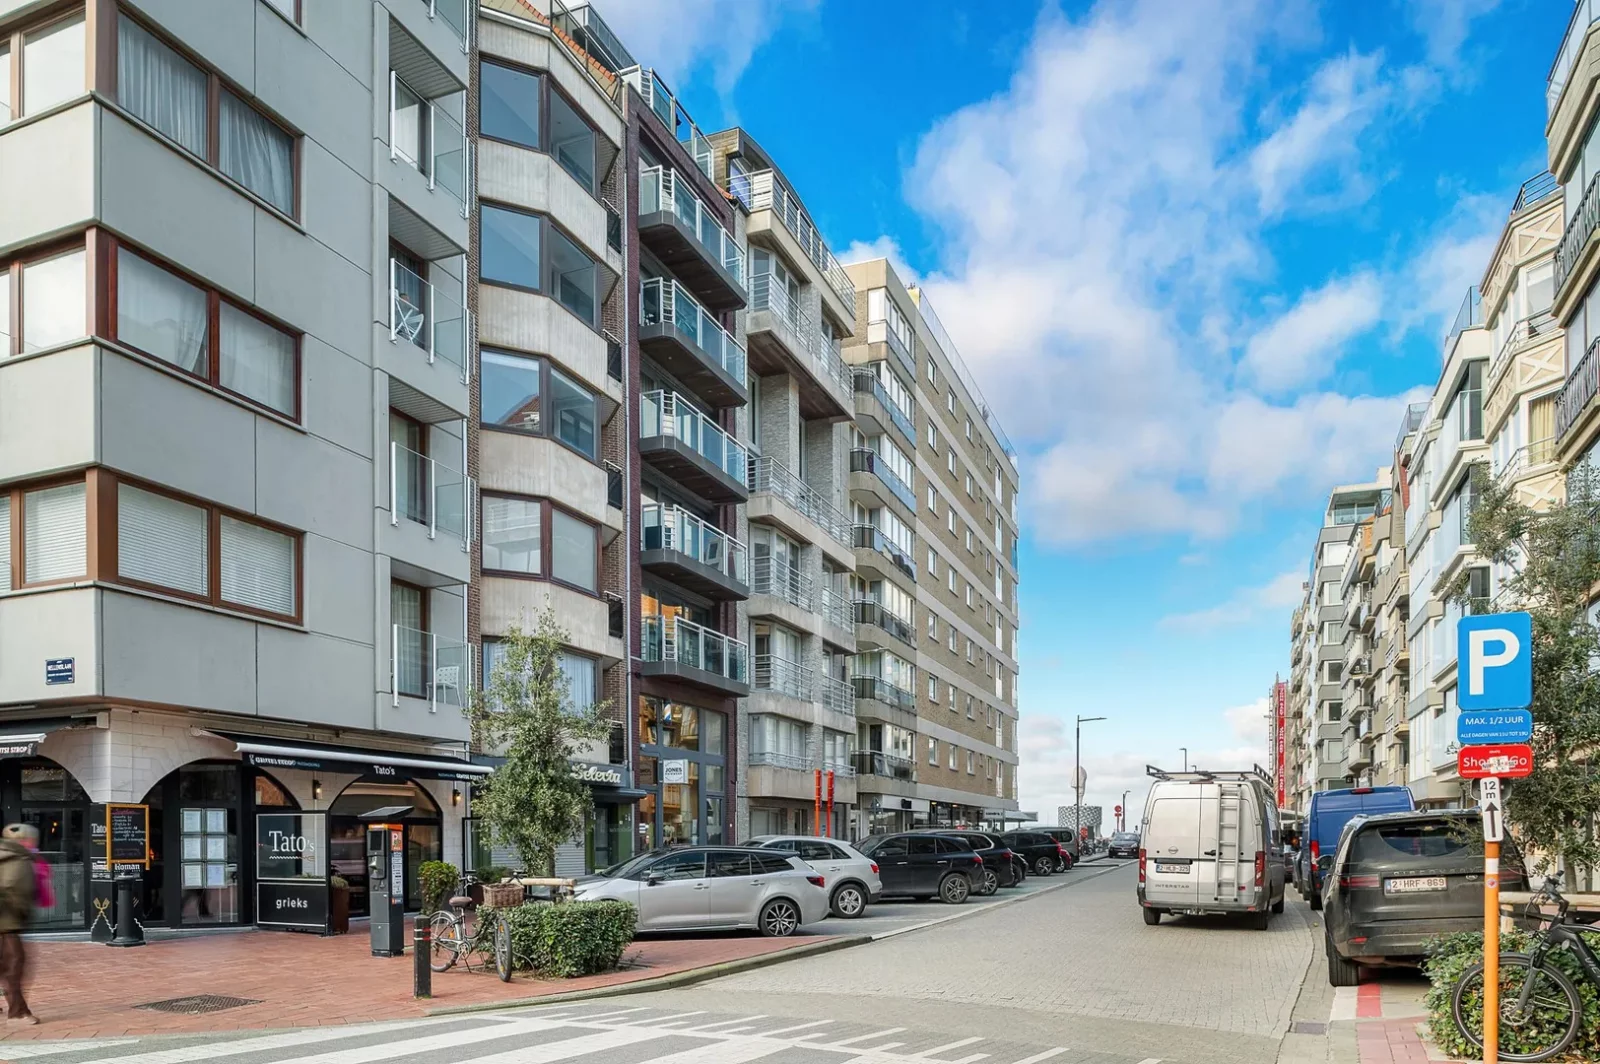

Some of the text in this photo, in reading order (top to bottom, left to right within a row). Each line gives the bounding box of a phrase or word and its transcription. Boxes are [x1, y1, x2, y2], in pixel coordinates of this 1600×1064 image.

[1469, 629, 1520, 695] P
[1465, 715, 1524, 726] MAX. 1/2 UUR
[373, 765, 396, 776] Tato's
[1483, 780, 1497, 791] 12
[268, 830, 315, 853] Tato's
[275, 897, 309, 909] grieks
